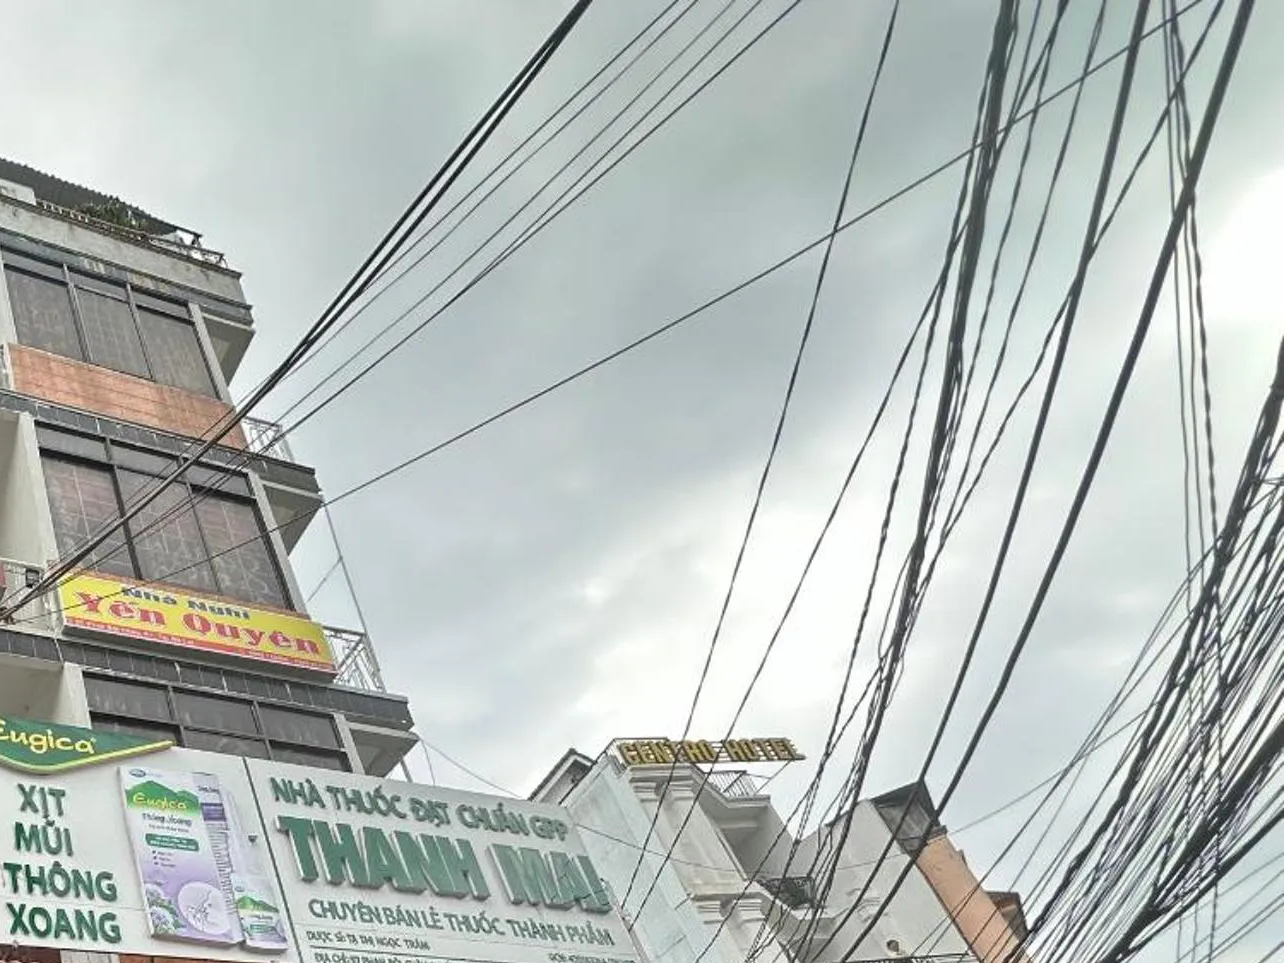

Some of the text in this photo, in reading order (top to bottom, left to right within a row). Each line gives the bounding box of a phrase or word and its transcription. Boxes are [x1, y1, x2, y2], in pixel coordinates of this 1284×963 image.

[17, 783, 66, 818] XỊT
[269, 776, 326, 808] NHÀ
[326, 778, 406, 820] THUỐC
[14, 816, 74, 857] MŨI
[3, 860, 117, 901] THÔNG
[276, 814, 614, 915] THANH MAI
[6, 902, 122, 944] XOANG
[308, 898, 384, 925] CHUYÊN
[383, 905, 422, 929] BÁN
[443, 910, 507, 936] THUỐC
